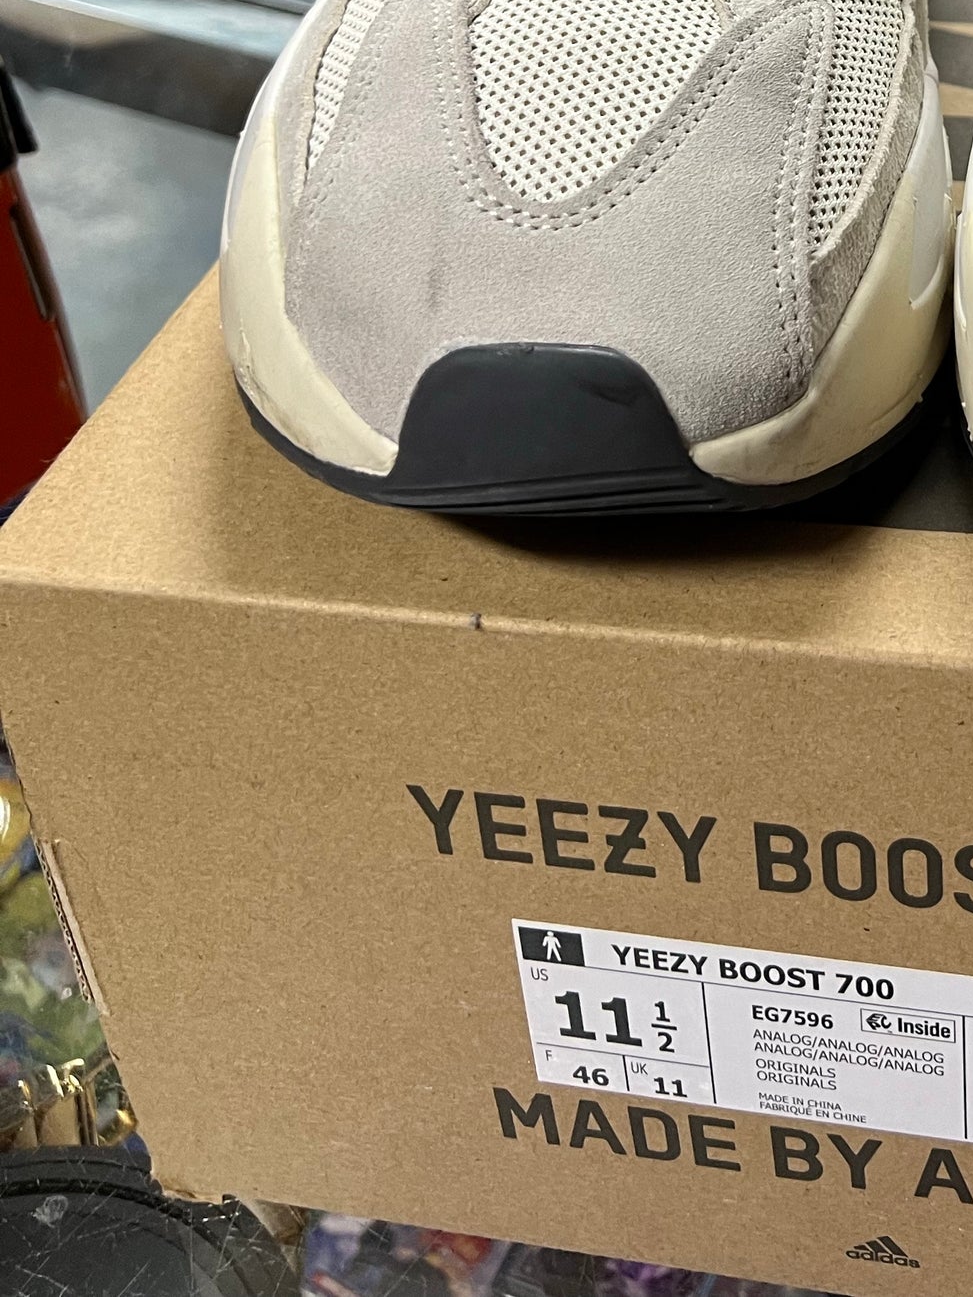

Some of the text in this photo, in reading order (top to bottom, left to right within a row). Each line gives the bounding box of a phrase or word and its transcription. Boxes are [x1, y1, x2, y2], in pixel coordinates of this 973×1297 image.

[406, 783, 718, 883] YEEZY
[531, 967, 549, 981] US
[611, 944, 894, 1000] YEEZY BOOST 700
[555, 991, 643, 1047] 11
[751, 1004, 834, 1029] EG7596
[898, 1017, 951, 1039] Inside
[753, 1029, 944, 1064] ANALOG/ANALOG/ANALOG
[631, 1061, 648, 1075] UK
[754, 1042, 945, 1076] ANALOG/ANALOG/ANALOG
[755, 1058, 836, 1078] ORIGINALS
[572, 1065, 609, 1086] 46
[757, 1071, 837, 1090] ORIGINALS
[653, 1077, 688, 1098] 11
[758, 1092, 842, 1111] MADE IN CHINA
[816, 1109, 830, 1118] EN
[833, 1112, 867, 1123] CHINE
[492, 1087, 741, 1172] MADE
[769, 1125, 883, 1189] BY
[845, 1249, 921, 1269] adidas
